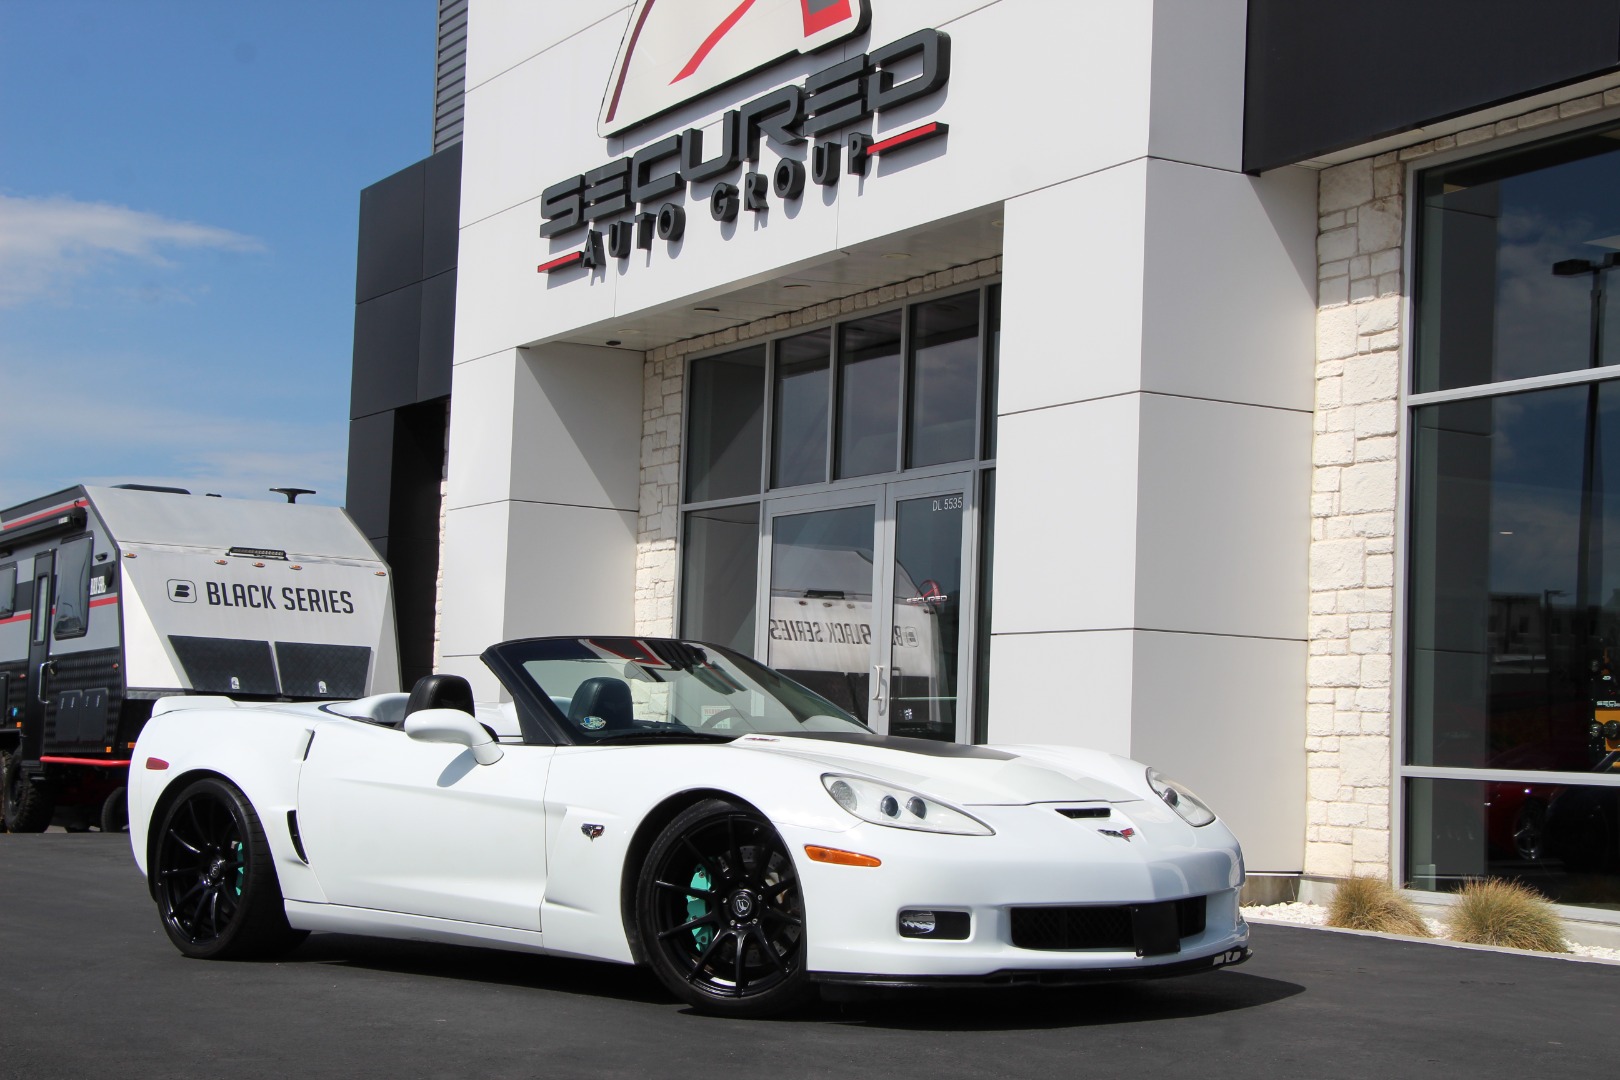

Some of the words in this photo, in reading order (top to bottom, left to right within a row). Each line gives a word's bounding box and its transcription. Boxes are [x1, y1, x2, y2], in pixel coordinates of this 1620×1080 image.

[540, 28, 951, 238] SECURED
[581, 203, 686, 270] AUTO
[710, 132, 874, 223] GROUP
[932, 499, 942, 512] DL
[944, 496, 963, 510] 5535
[206, 581, 276, 609] BLACK
[282, 586, 354, 614] SERIES
